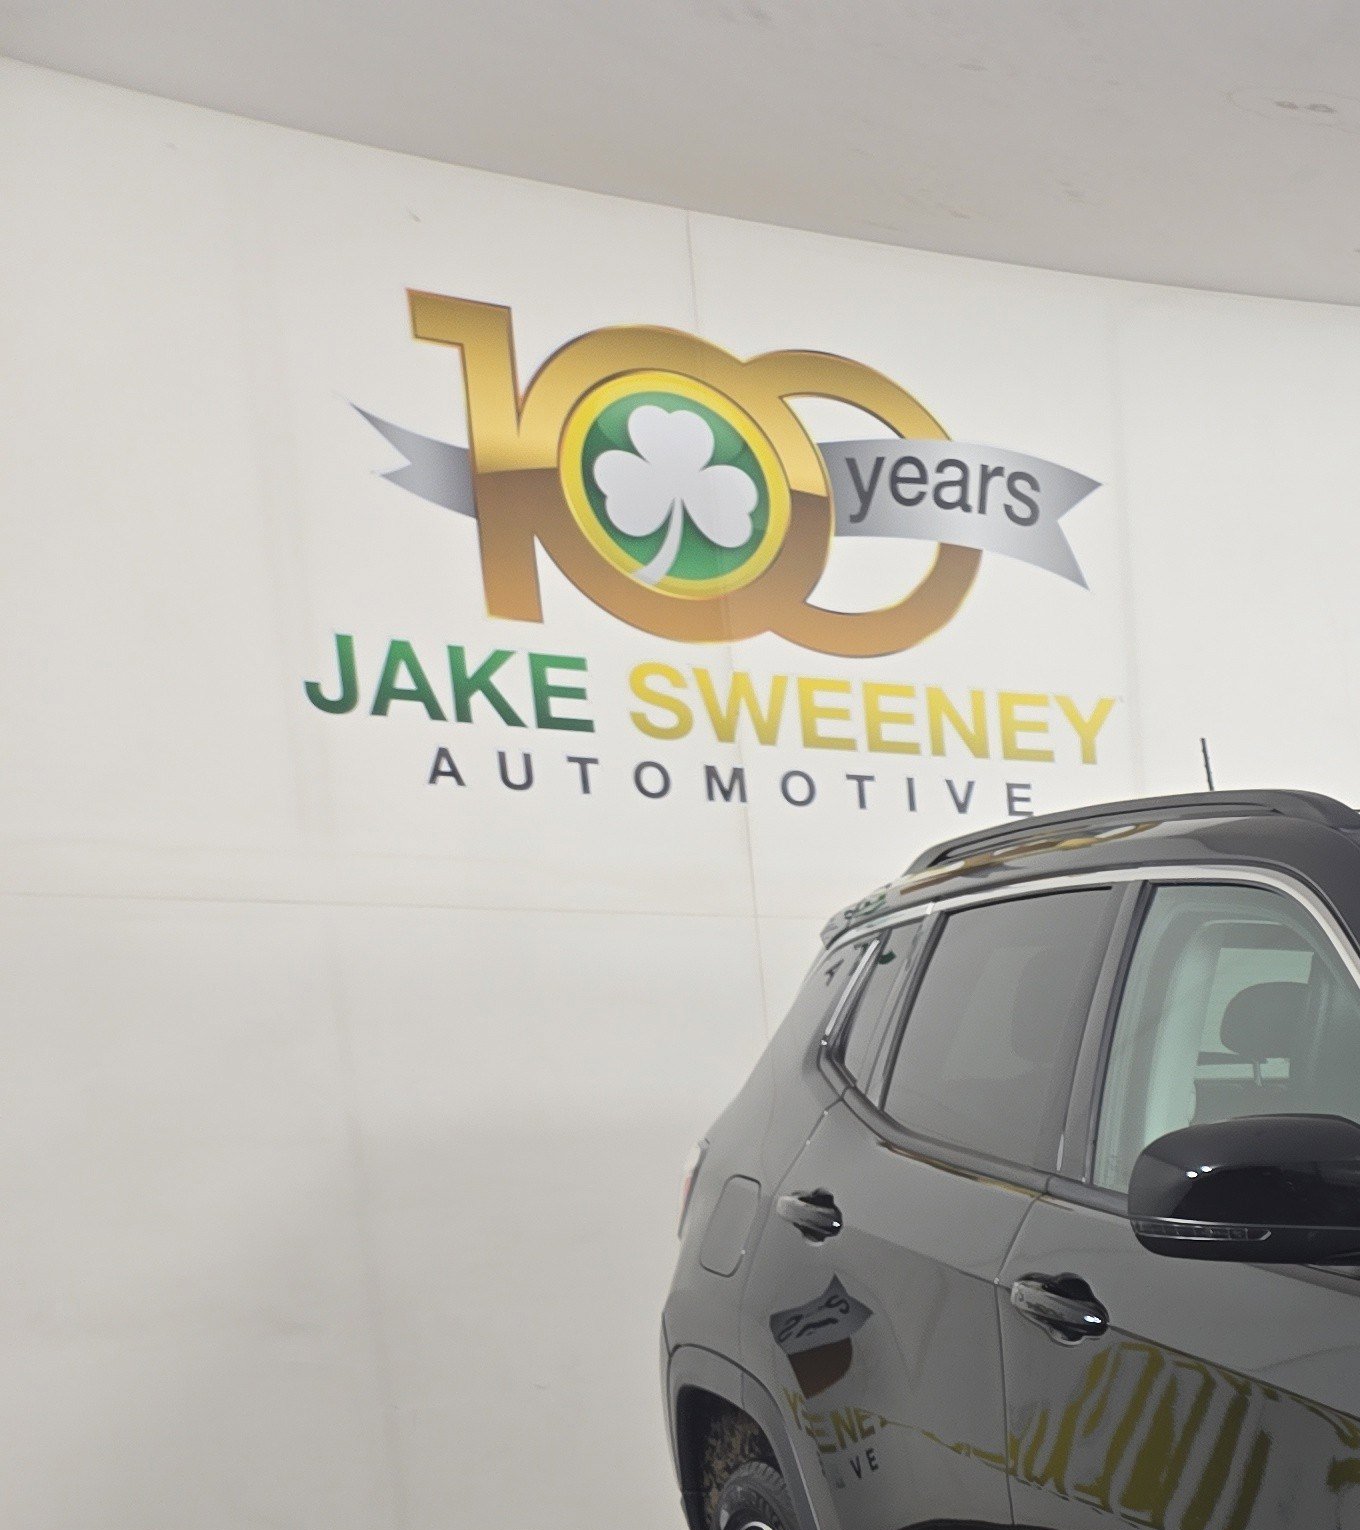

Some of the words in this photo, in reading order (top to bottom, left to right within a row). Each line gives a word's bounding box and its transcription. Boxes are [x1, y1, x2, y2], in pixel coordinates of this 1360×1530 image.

[845, 446, 1041, 526] years
[303, 633, 596, 732] JAKE
[629, 661, 1115, 765] SWEENEY
[427, 746, 1034, 817] AUTOMOTIVE
